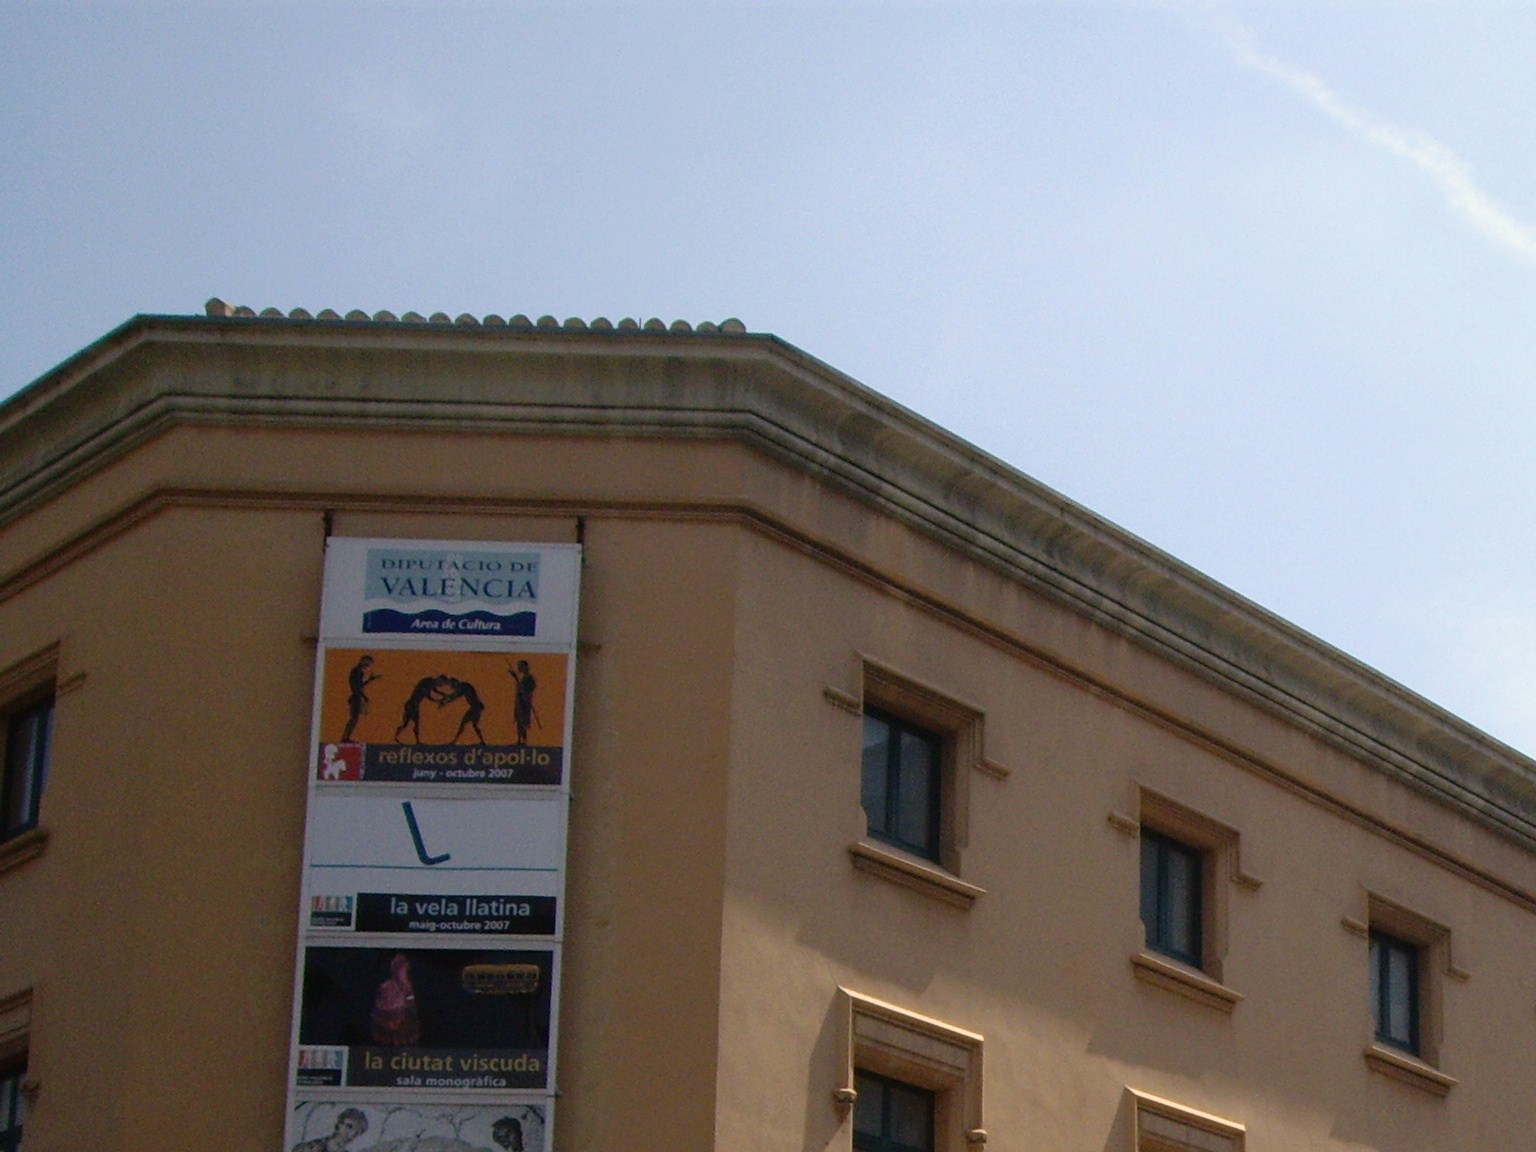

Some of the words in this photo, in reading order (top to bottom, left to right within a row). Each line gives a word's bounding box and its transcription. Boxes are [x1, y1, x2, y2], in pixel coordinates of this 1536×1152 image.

[510, 561, 538, 573] DE
[442, 619, 456, 630] de
[458, 618, 502, 631] Cultura
[379, 748, 458, 766] reflexos
[413, 768, 437, 780] juny
[446, 768, 486, 779] octubre
[488, 768, 514, 779] 2007
[390, 896, 409, 915] la
[415, 897, 459, 916] vela
[466, 897, 531, 917] llatina
[409, 919, 482, 932] maig-octubre
[484, 920, 510, 931] 2007
[364, 1051, 383, 1070] la
[391, 1053, 453, 1072] ciutat
[460, 1054, 541, 1073] viscuda
[396, 1075, 422, 1087] sala
